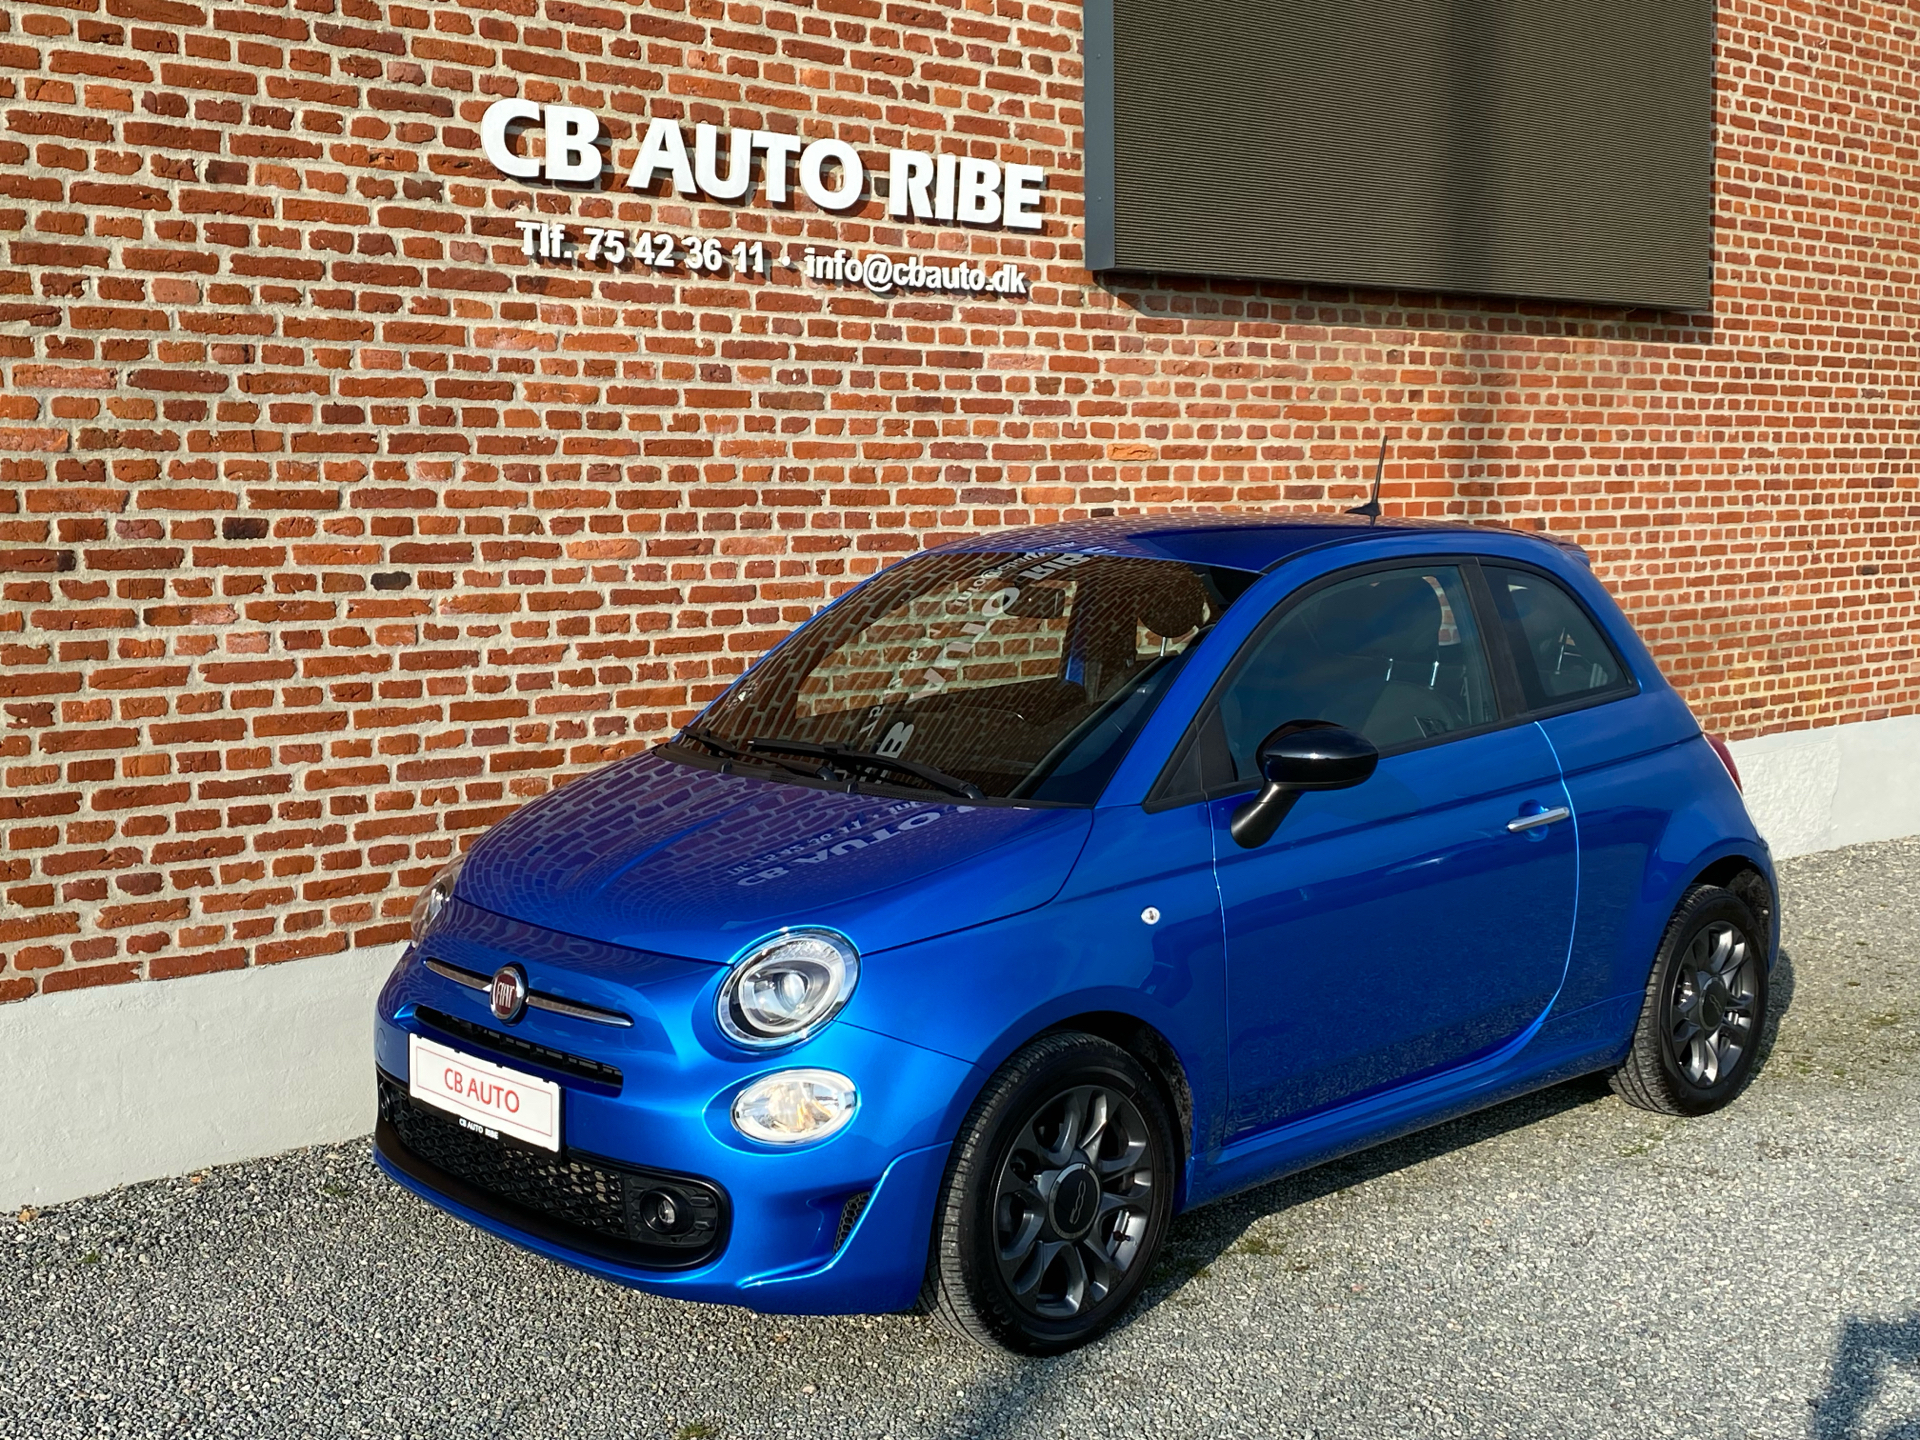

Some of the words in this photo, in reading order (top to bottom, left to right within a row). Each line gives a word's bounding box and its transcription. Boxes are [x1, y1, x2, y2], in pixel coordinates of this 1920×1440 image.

[480, 98, 602, 183] CB
[626, 117, 864, 211] AUTO
[888, 149, 1046, 230] RIBE
[515, 220, 572, 259] Tlf.
[583, 227, 626, 264] 75
[634, 231, 675, 268] 42
[681, 236, 723, 272] 36
[732, 241, 765, 273] 11
[803, 247, 1028, 294] info@cbauto.dk
[496, 981, 515, 1009] FIAT
[444, 1067, 464, 1094] CB
[467, 1077, 520, 1114] AUTO
[467, 1121, 484, 1134] AUTO
